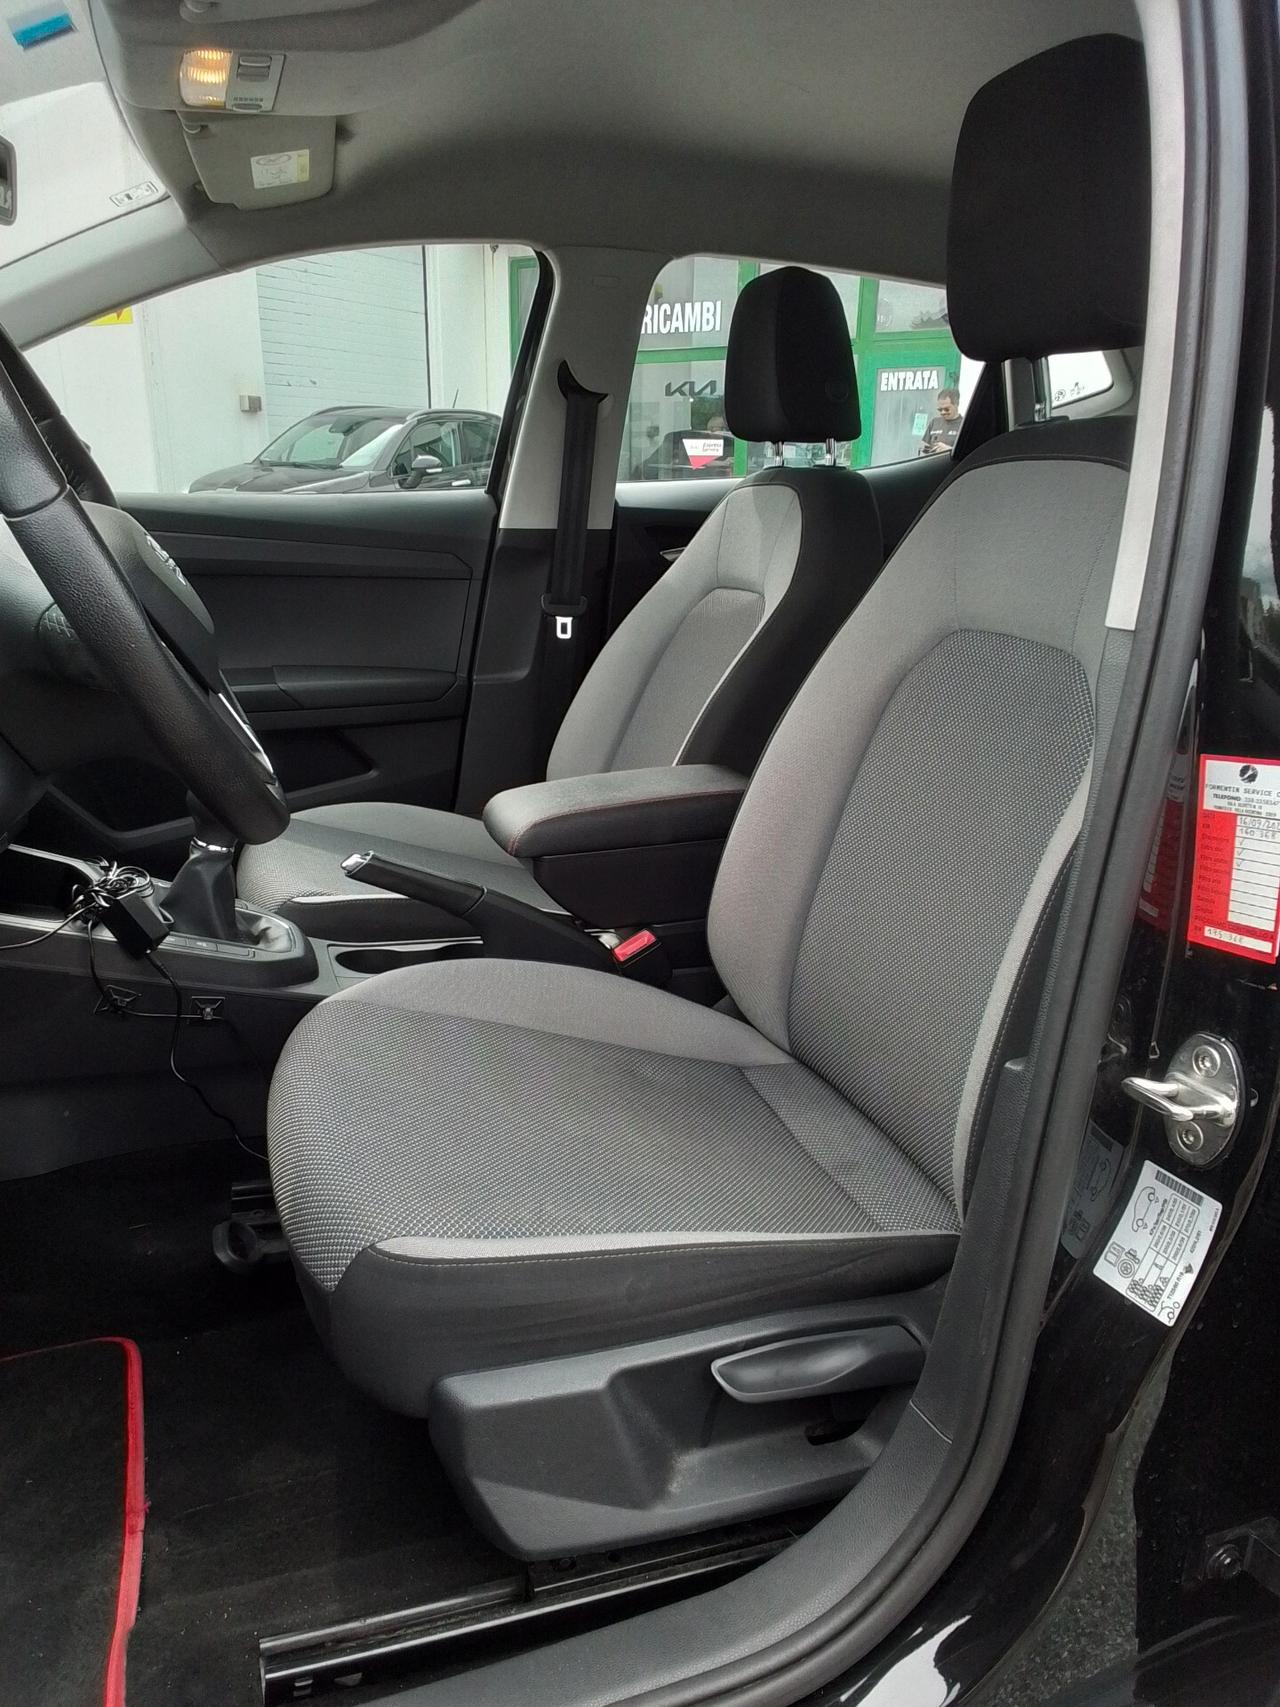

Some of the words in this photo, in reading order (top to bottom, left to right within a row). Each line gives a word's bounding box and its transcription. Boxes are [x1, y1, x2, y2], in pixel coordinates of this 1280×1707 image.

[641, 300, 721, 334] RICAMBI
[665, 380, 717, 397] KIA
[880, 370, 939, 391] ENTRATA
[1244, 788, 1273, 797] SERVICE
